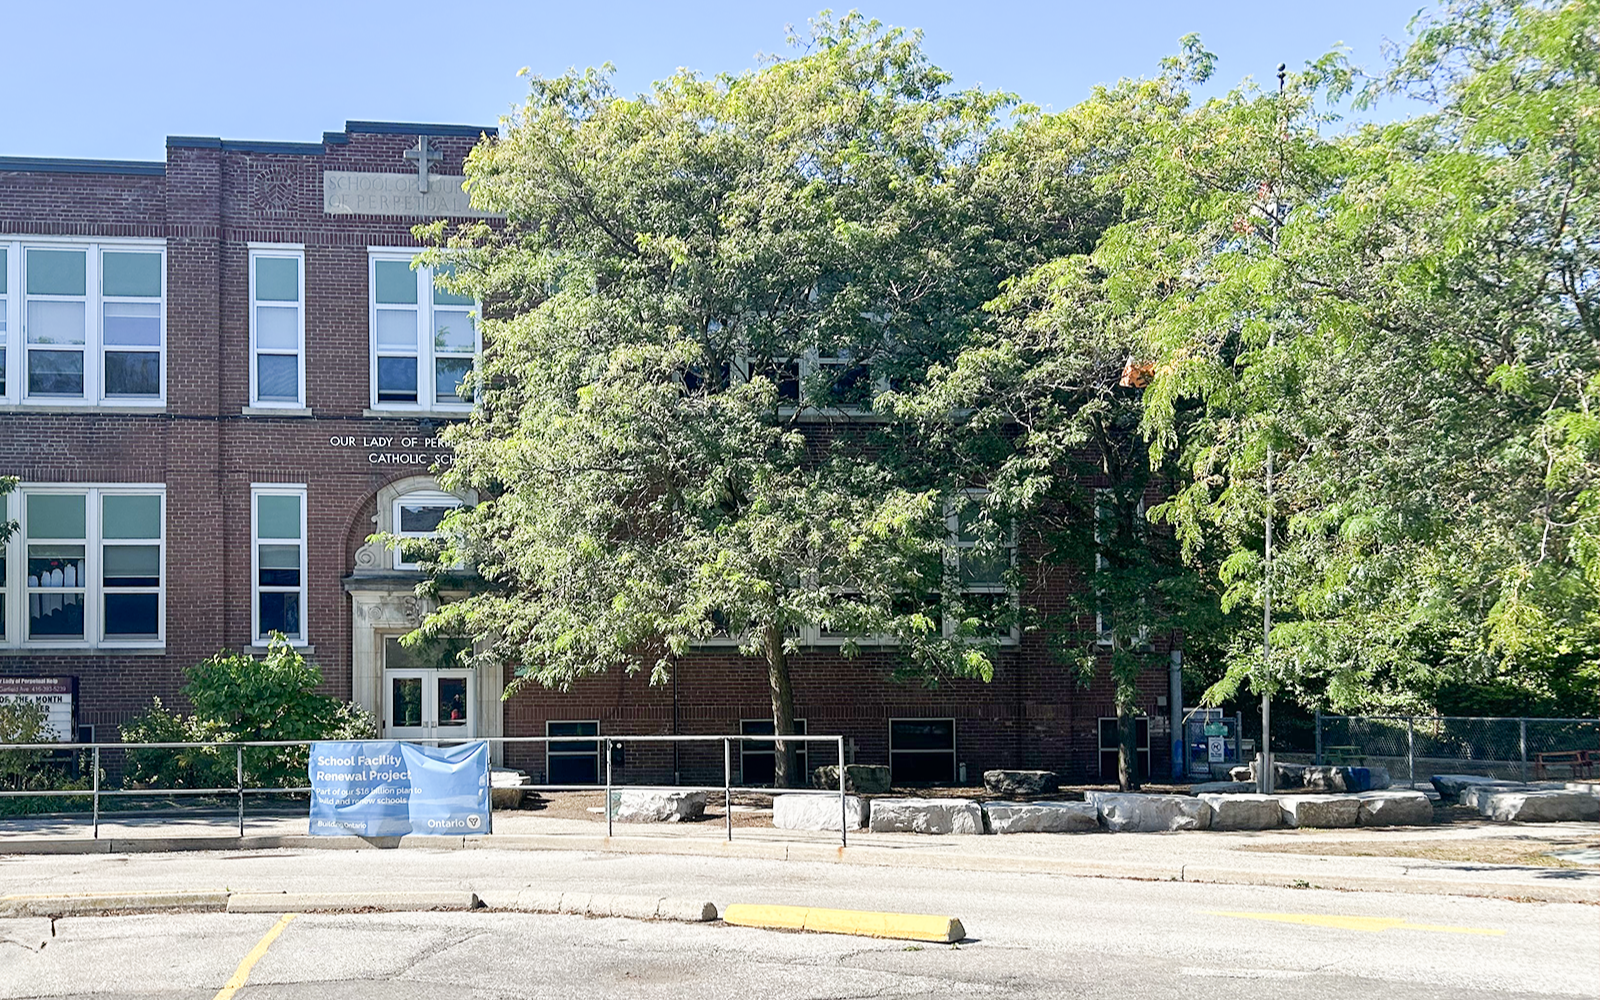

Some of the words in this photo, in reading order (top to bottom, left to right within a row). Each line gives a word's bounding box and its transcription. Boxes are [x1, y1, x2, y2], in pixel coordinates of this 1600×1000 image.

[328, 176, 392, 191] SCHOOL
[395, 178, 415, 192] OF
[329, 193, 350, 208] OF
[357, 194, 461, 212] PERPETUAL
[330, 436, 357, 447] OUR
[363, 437, 394, 447] LADY
[401, 437, 418, 447] OF
[368, 453, 427, 464] CATHOLIC
[14, 695, 29, 703] THE
[35, 695, 63, 703] MONTH
[317, 755, 355, 766] School
[358, 755, 402, 767] Facility
[316, 771, 367, 781] Renewal
[369, 769, 412, 782] Project
[371, 787, 395, 795] billion
[396, 787, 413, 796] plan
[377, 797, 407, 805] schools
[427, 819, 465, 829] Ontario
